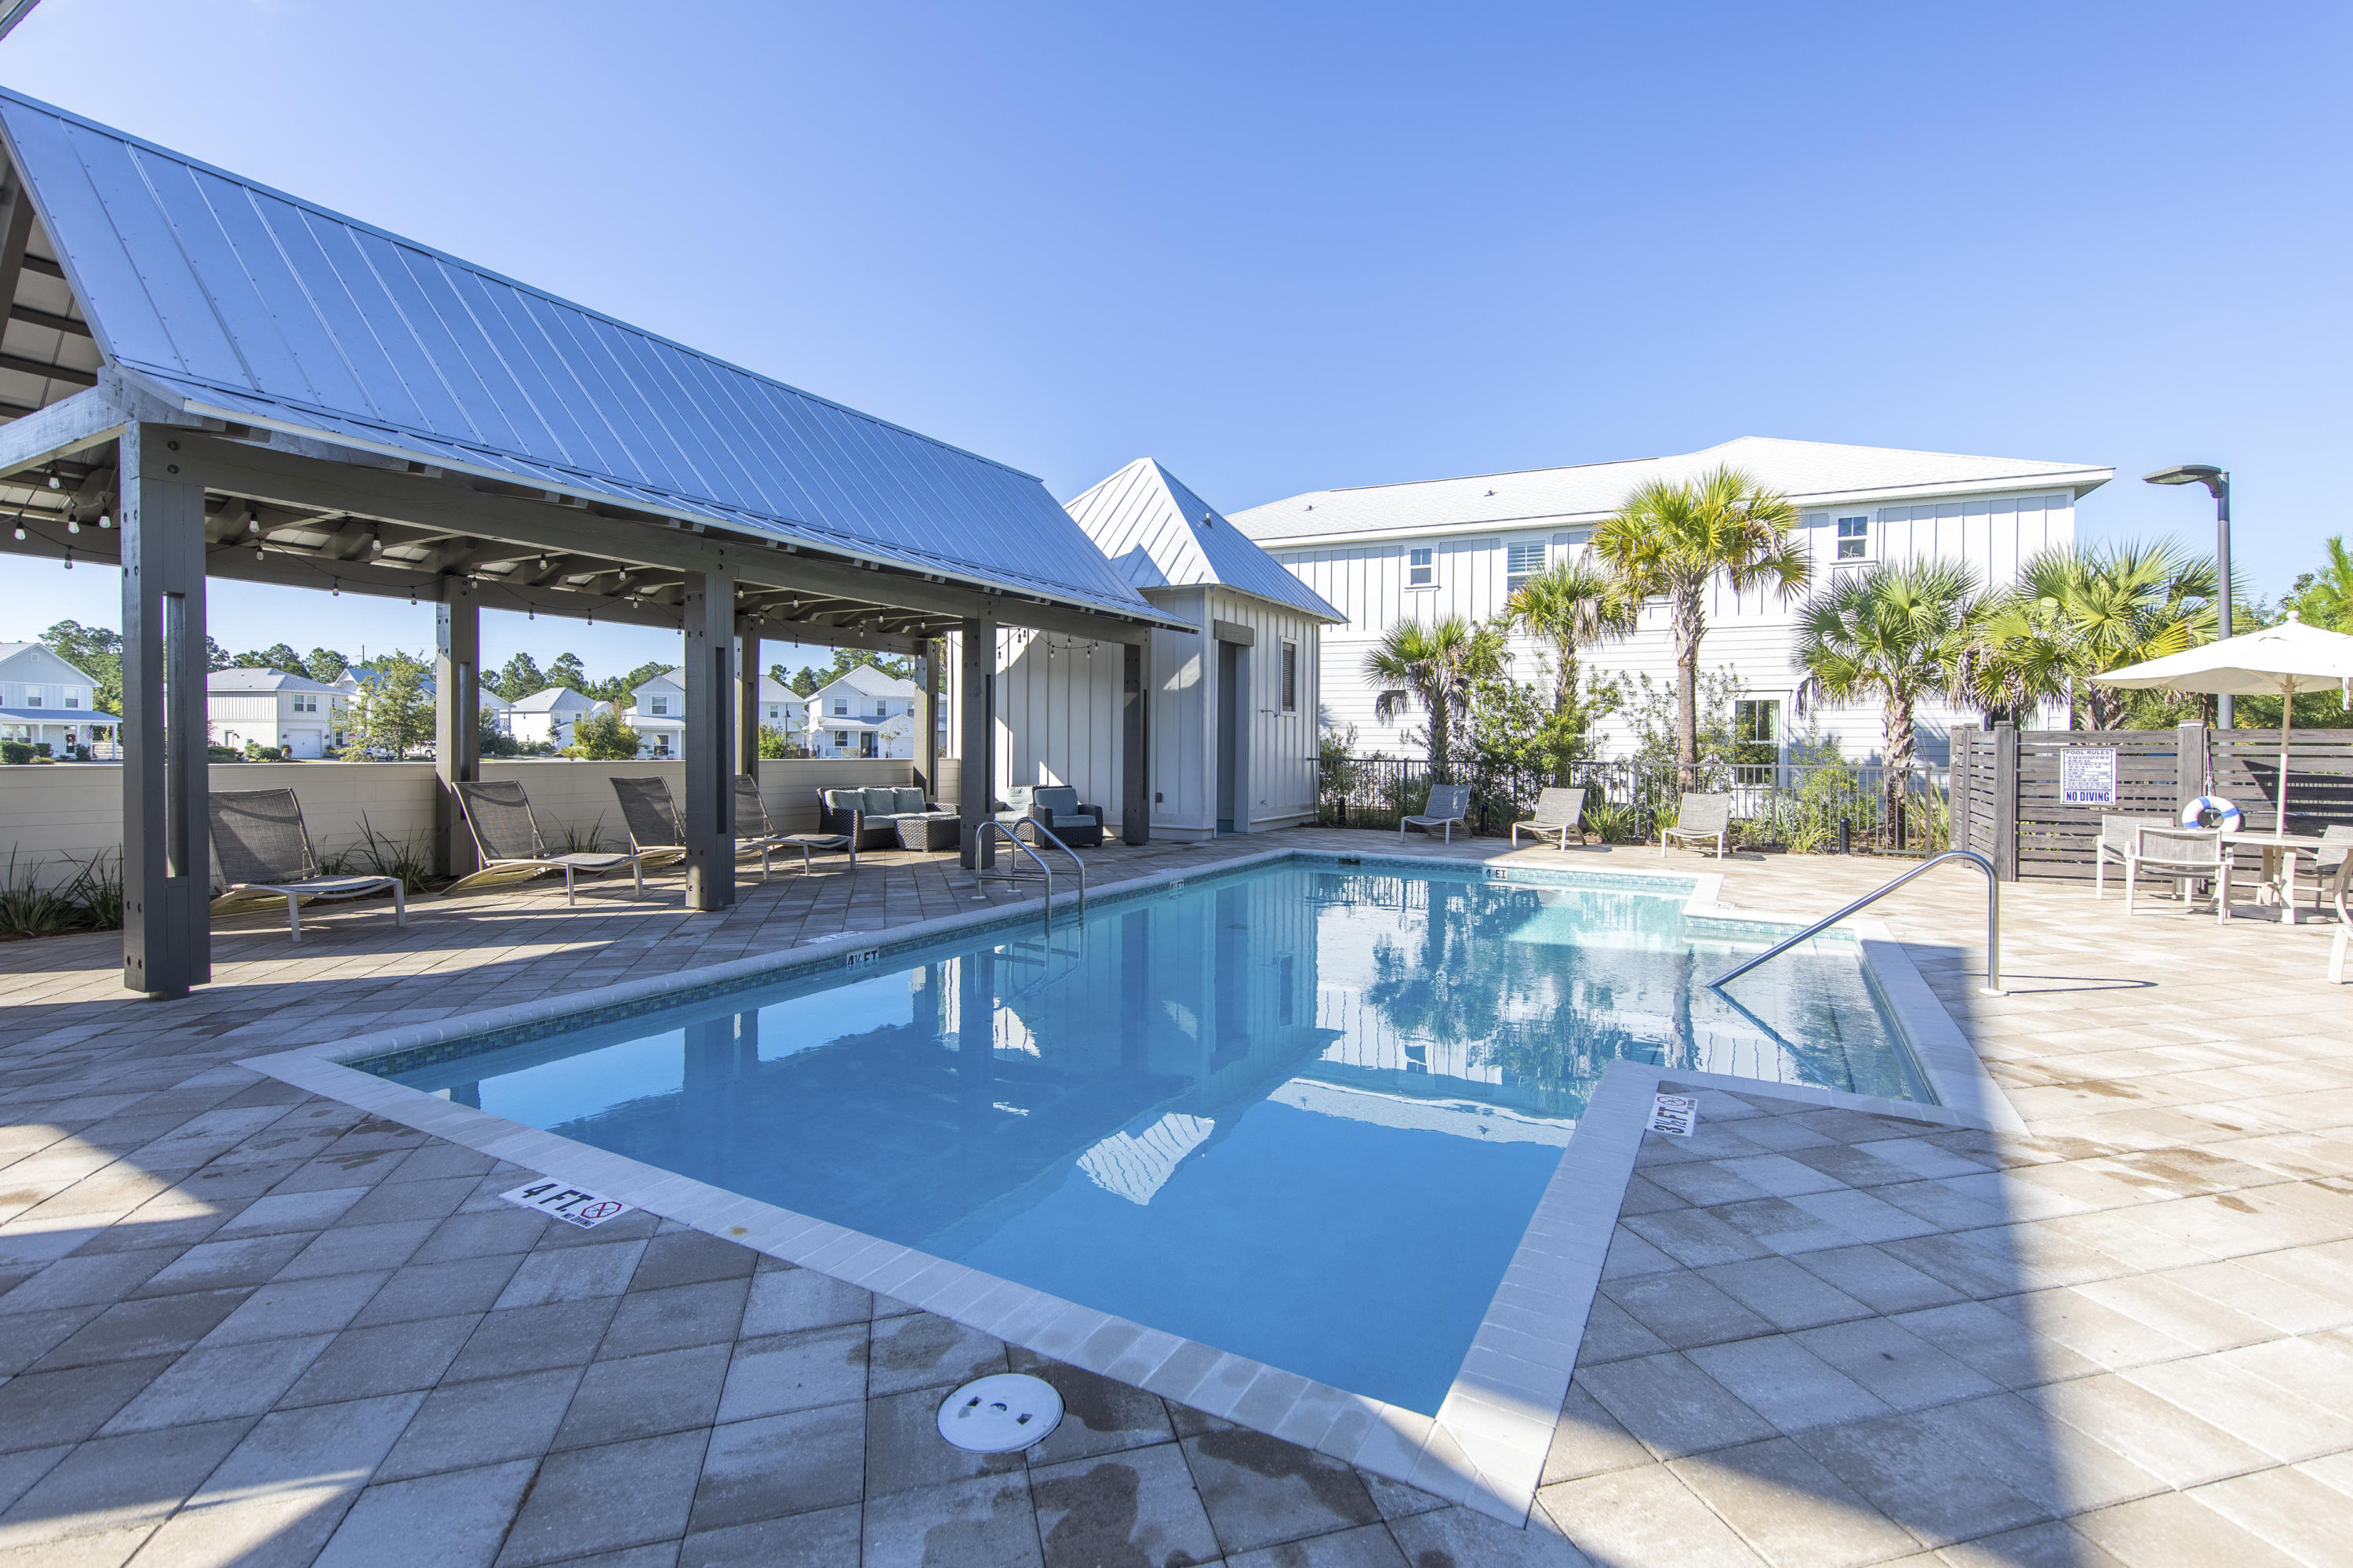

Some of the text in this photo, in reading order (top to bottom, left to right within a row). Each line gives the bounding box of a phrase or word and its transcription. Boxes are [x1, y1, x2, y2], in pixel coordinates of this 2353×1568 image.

[2066, 791, 2110, 802] NO DIVING
[522, 1183, 558, 1199] 4
[569, 1216, 595, 1228] DIVING
